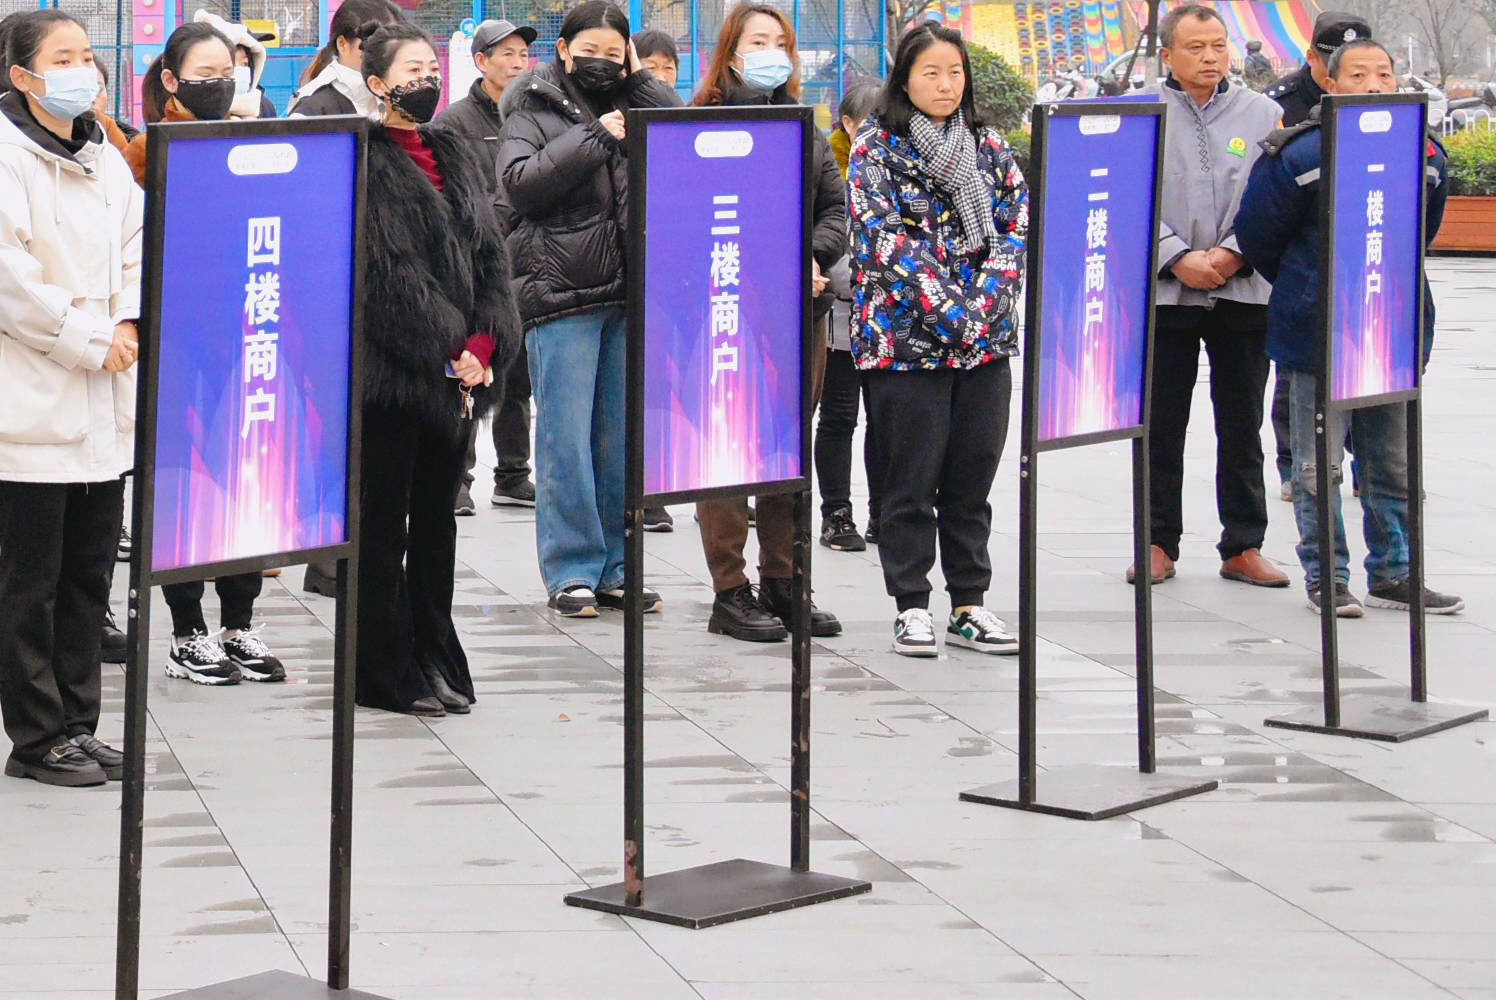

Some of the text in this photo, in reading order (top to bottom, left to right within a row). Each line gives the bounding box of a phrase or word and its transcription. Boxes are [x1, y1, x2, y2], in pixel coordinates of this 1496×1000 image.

[710, 195, 741, 386] 三楼商户
[1083, 167, 1109, 337] 二楼商户
[1364, 164, 1385, 305] 一楼商户
[240, 216, 282, 440] 四楼商户
